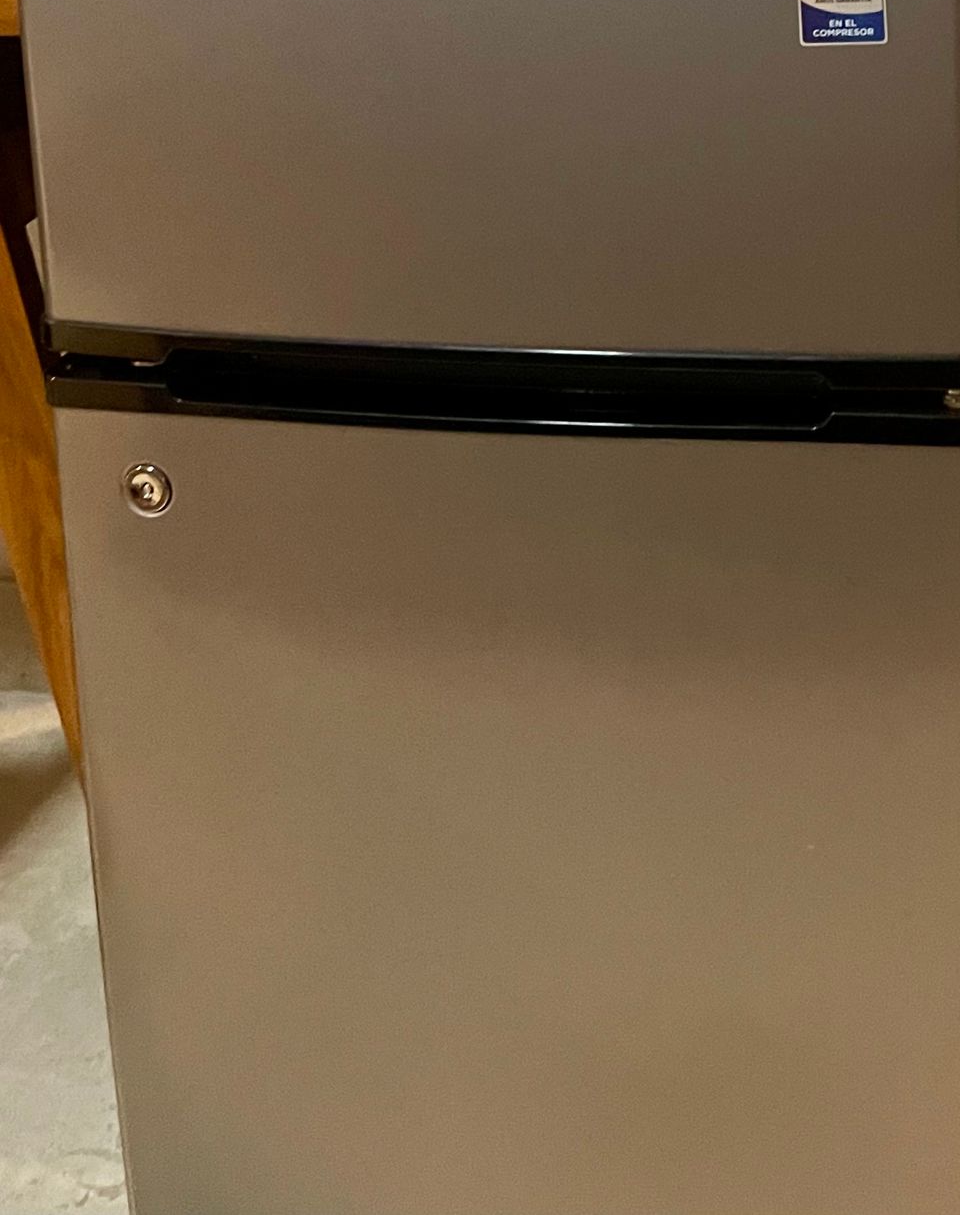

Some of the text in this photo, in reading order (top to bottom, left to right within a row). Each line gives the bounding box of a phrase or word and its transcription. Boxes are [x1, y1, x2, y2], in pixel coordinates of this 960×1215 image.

[828, 19, 857, 28] EN EL
[812, 28, 874, 37] COMPRESOR
